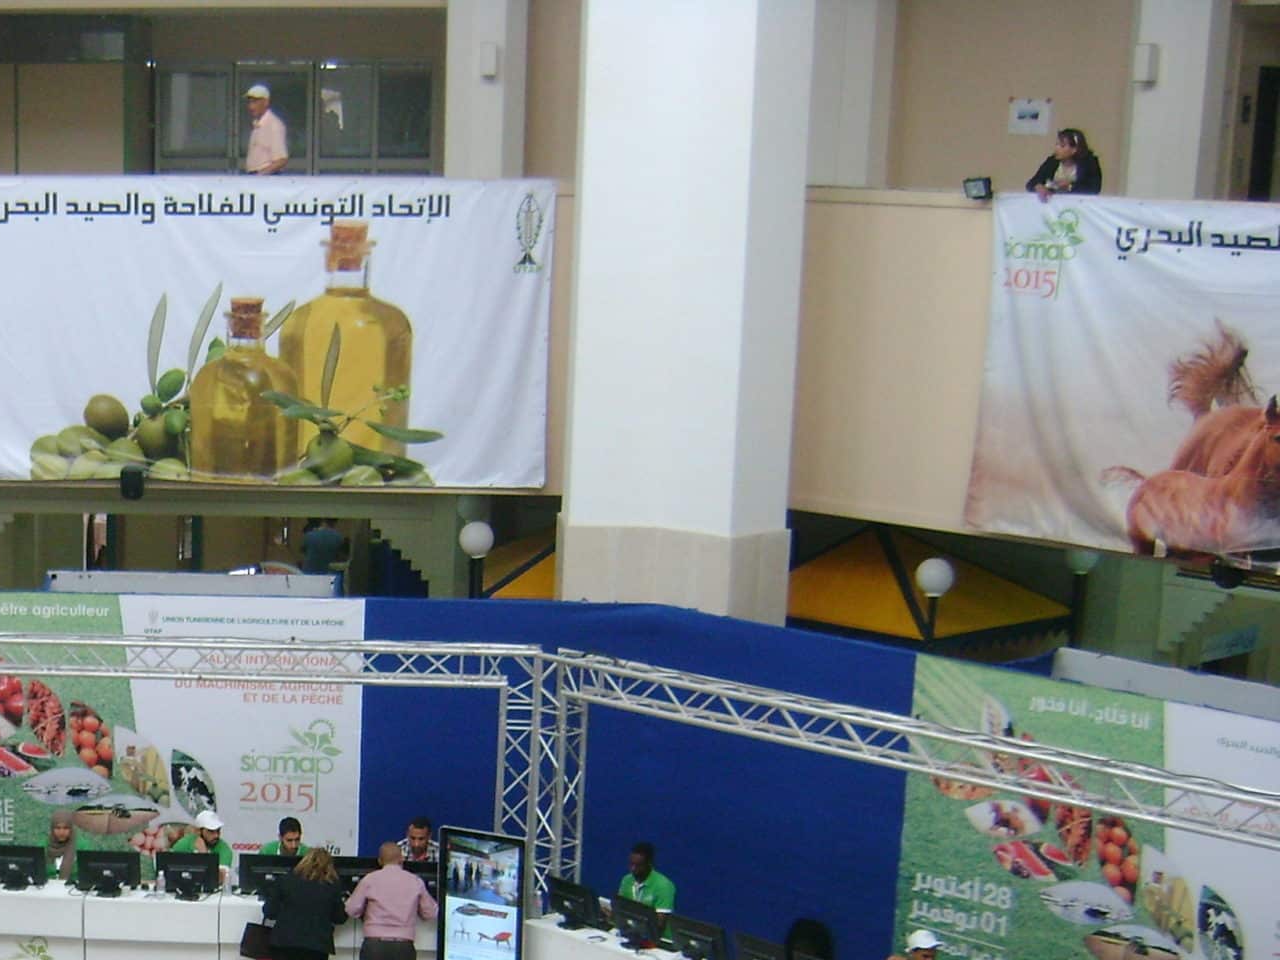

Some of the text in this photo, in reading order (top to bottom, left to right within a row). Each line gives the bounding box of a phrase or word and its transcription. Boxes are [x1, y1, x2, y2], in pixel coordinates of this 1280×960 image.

[65, 192, 156, 224] والصيد
[163, 193, 256, 217] للفلاحة
[263, 193, 365, 233] التونسي
[1115, 220, 1203, 261] البحري
[31, 604, 111, 618] agriculteur
[203, 654, 342, 667] ALN INTRNAIONA
[174, 678, 344, 693] DU MACHINISME AGRICOLE
[243, 692, 257, 703] ET
[261, 692, 276, 704] DE
[282, 693, 298, 704] LA
[240, 749, 335, 775] siamap
[240, 781, 315, 813] 2015
[982, 882, 1012, 910] 28
[980, 910, 1008, 937] 01
